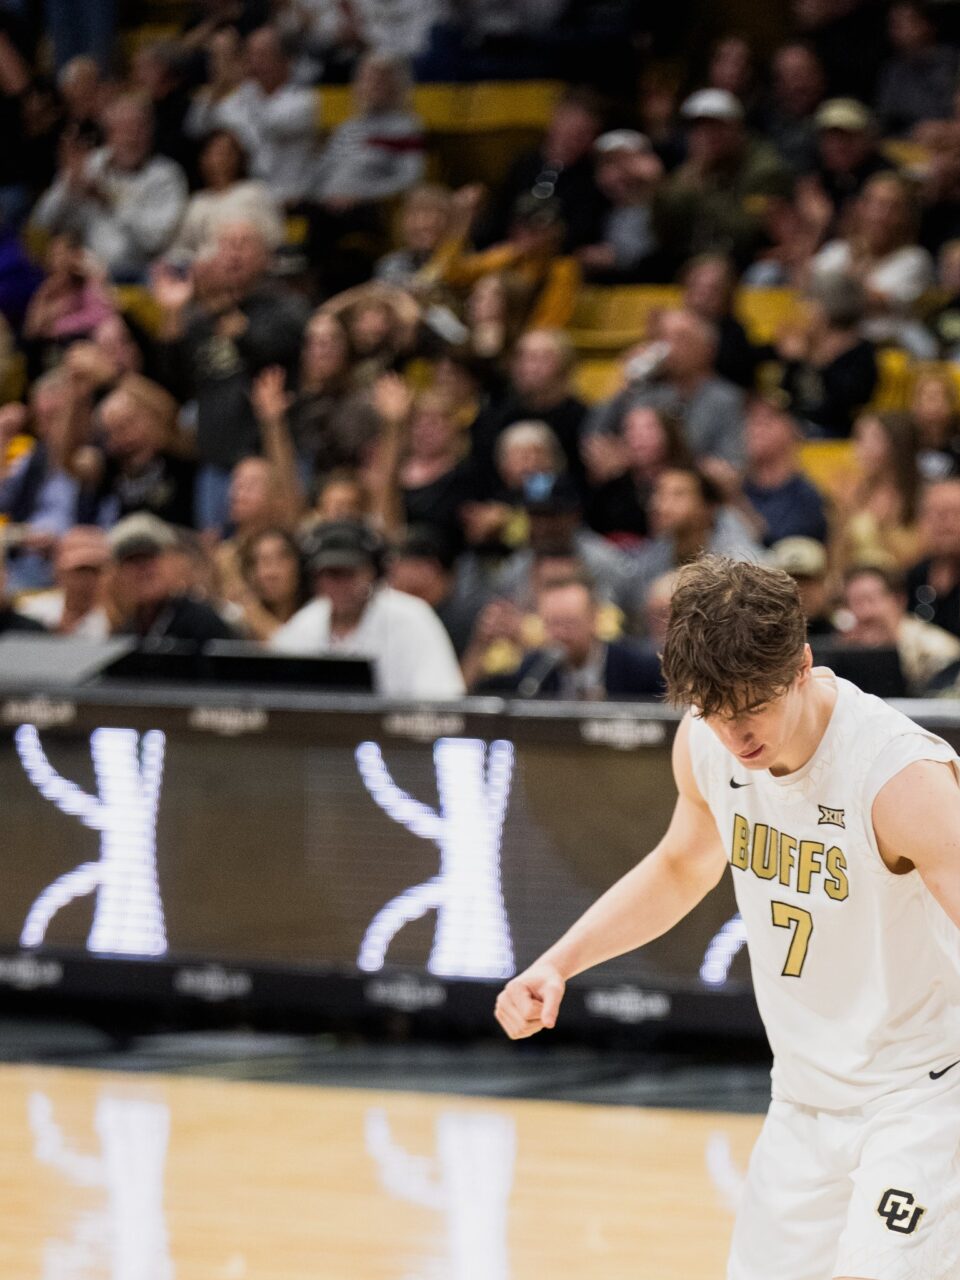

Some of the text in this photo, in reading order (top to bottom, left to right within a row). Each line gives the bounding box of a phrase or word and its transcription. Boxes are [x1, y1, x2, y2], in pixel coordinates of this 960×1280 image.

[731, 813, 849, 902] BUFFS
[771, 900, 814, 978] 7
[877, 1188, 926, 1236] CU
